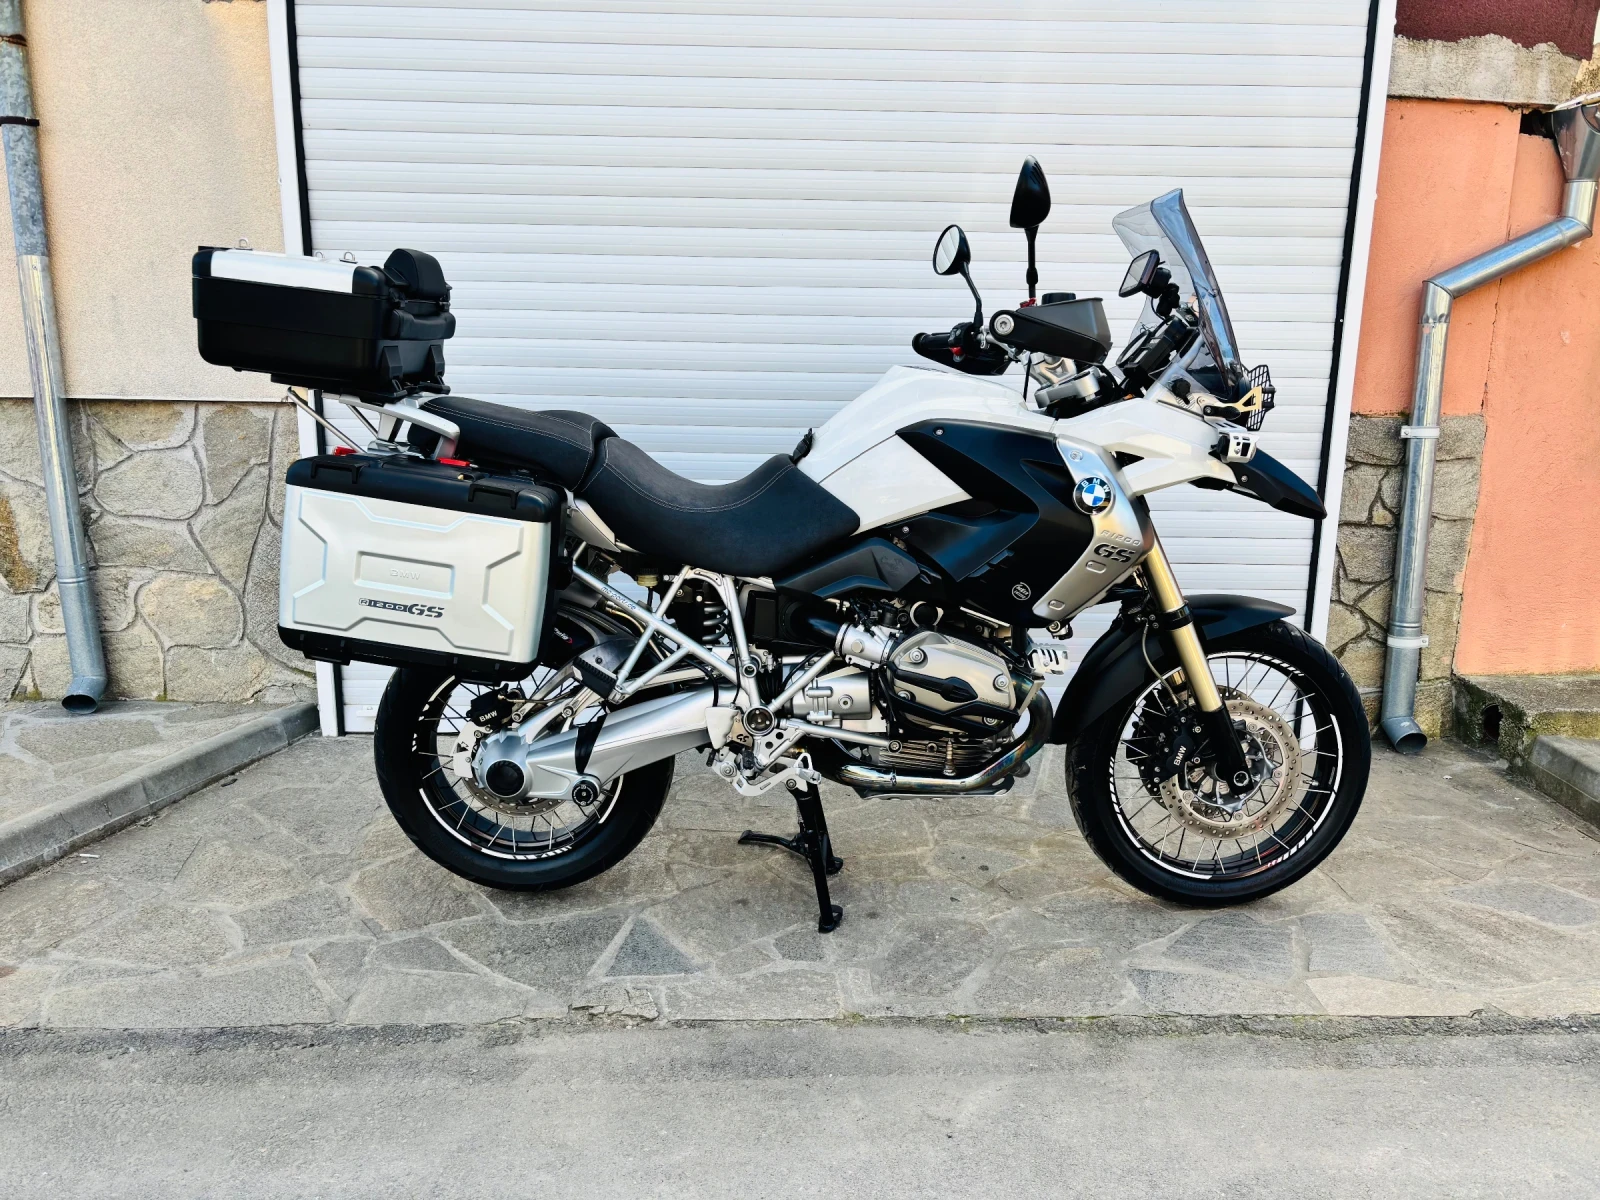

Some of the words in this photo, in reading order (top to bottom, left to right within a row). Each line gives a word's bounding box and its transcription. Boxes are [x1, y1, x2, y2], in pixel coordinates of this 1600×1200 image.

[1081, 478, 1111, 492] BMW
[1094, 543, 1135, 563] GS
[389, 569, 421, 580] BMW
[479, 710, 497, 722] BMW
[736, 734, 749, 742] GS
[1173, 745, 1187, 766] BMW
